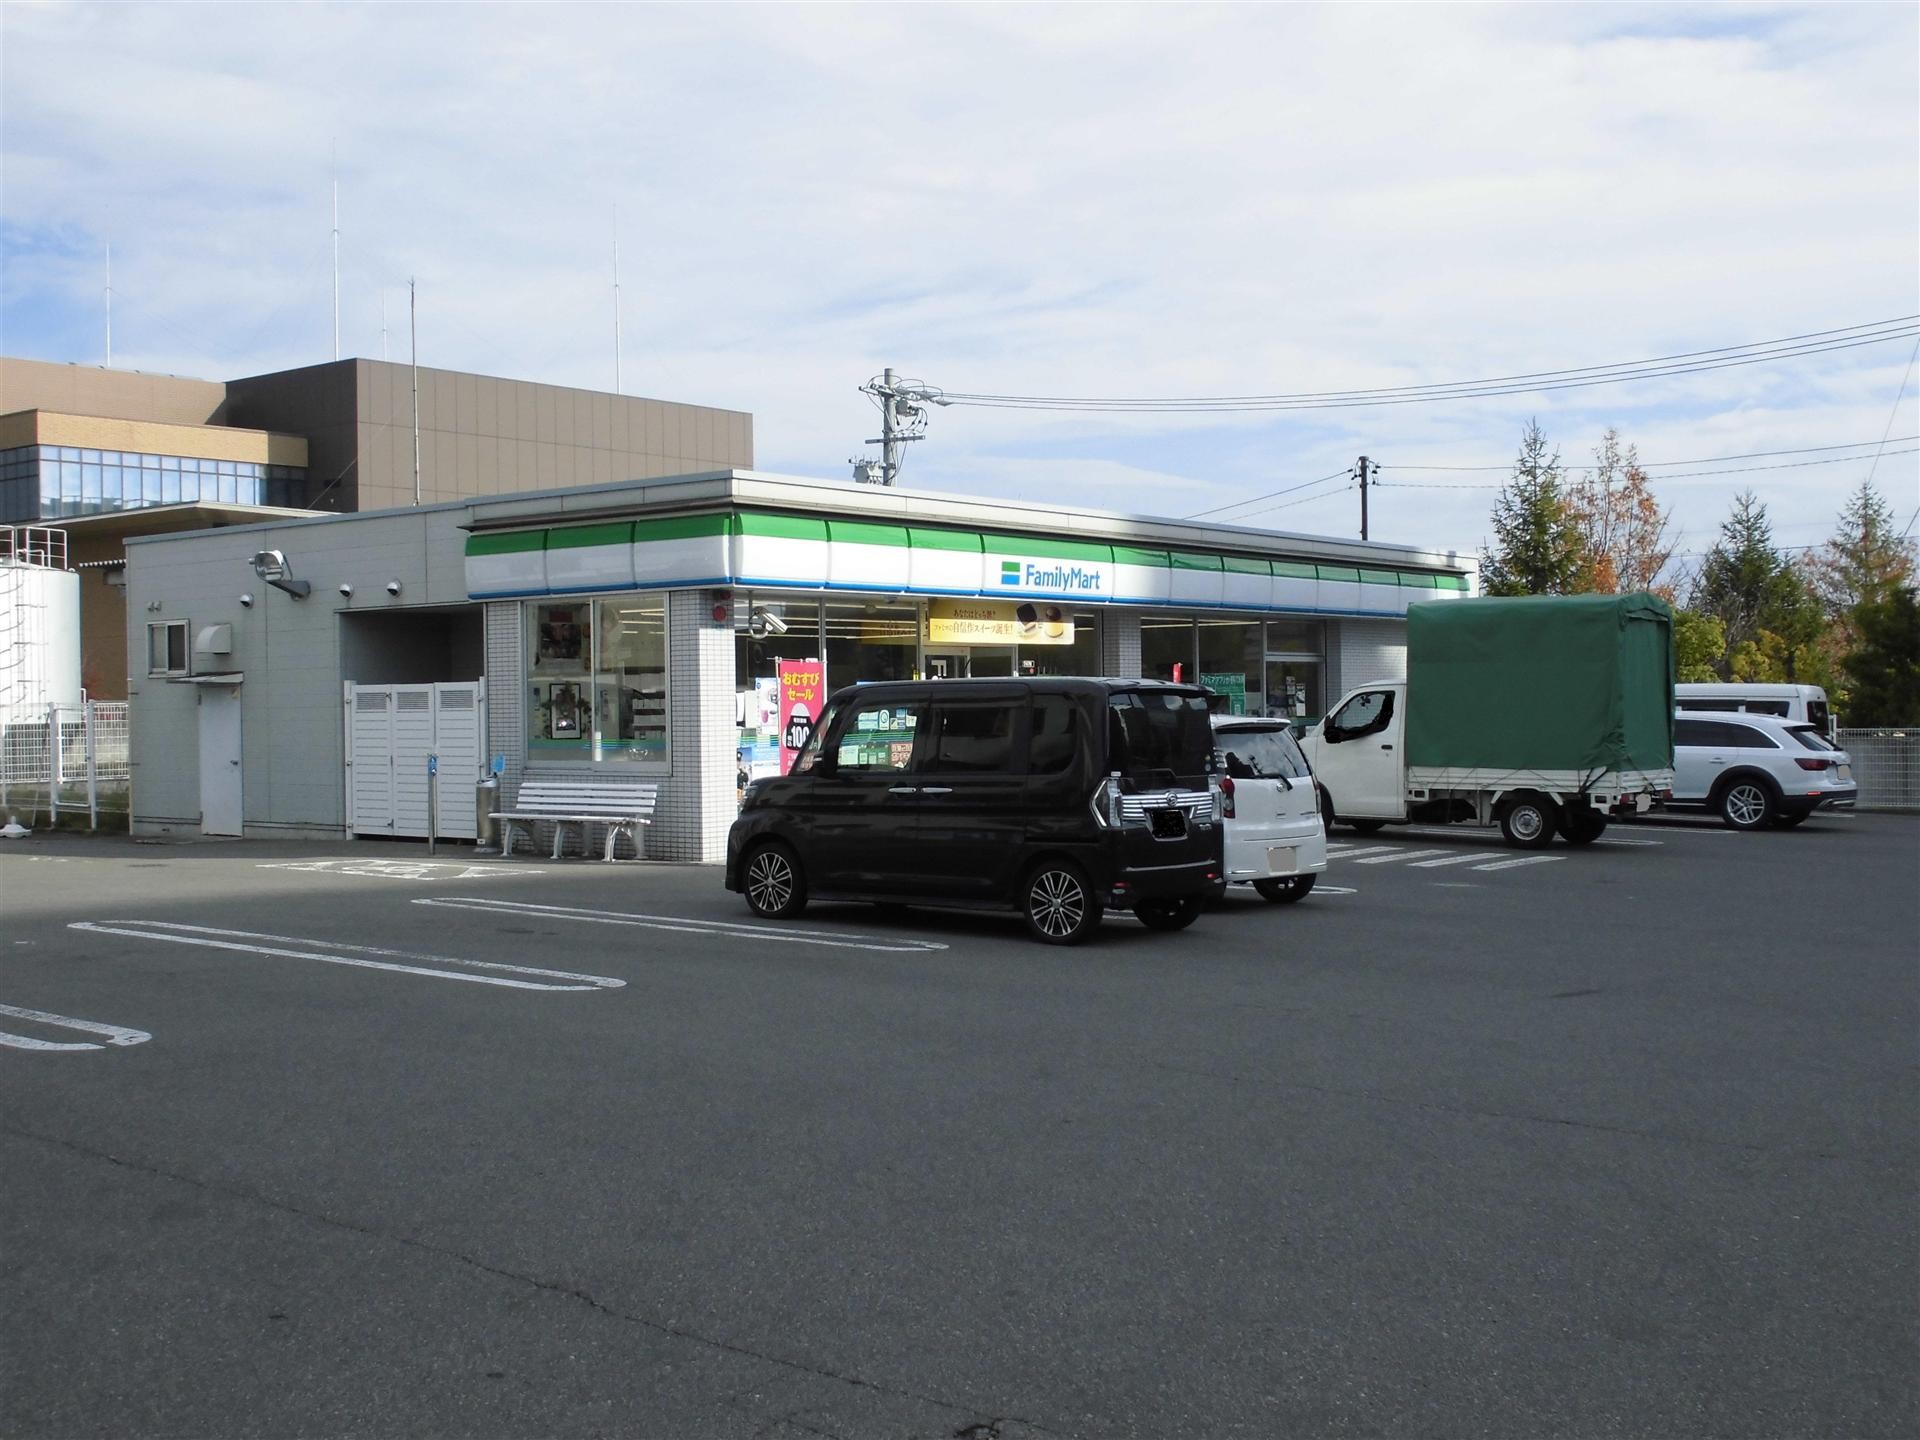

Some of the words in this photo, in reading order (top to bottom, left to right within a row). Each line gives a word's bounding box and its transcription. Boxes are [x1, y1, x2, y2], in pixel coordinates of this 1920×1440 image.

[1026, 564, 1100, 591] FamilyMart
[783, 672, 819, 687] おむすび
[788, 688, 814, 701] セール
